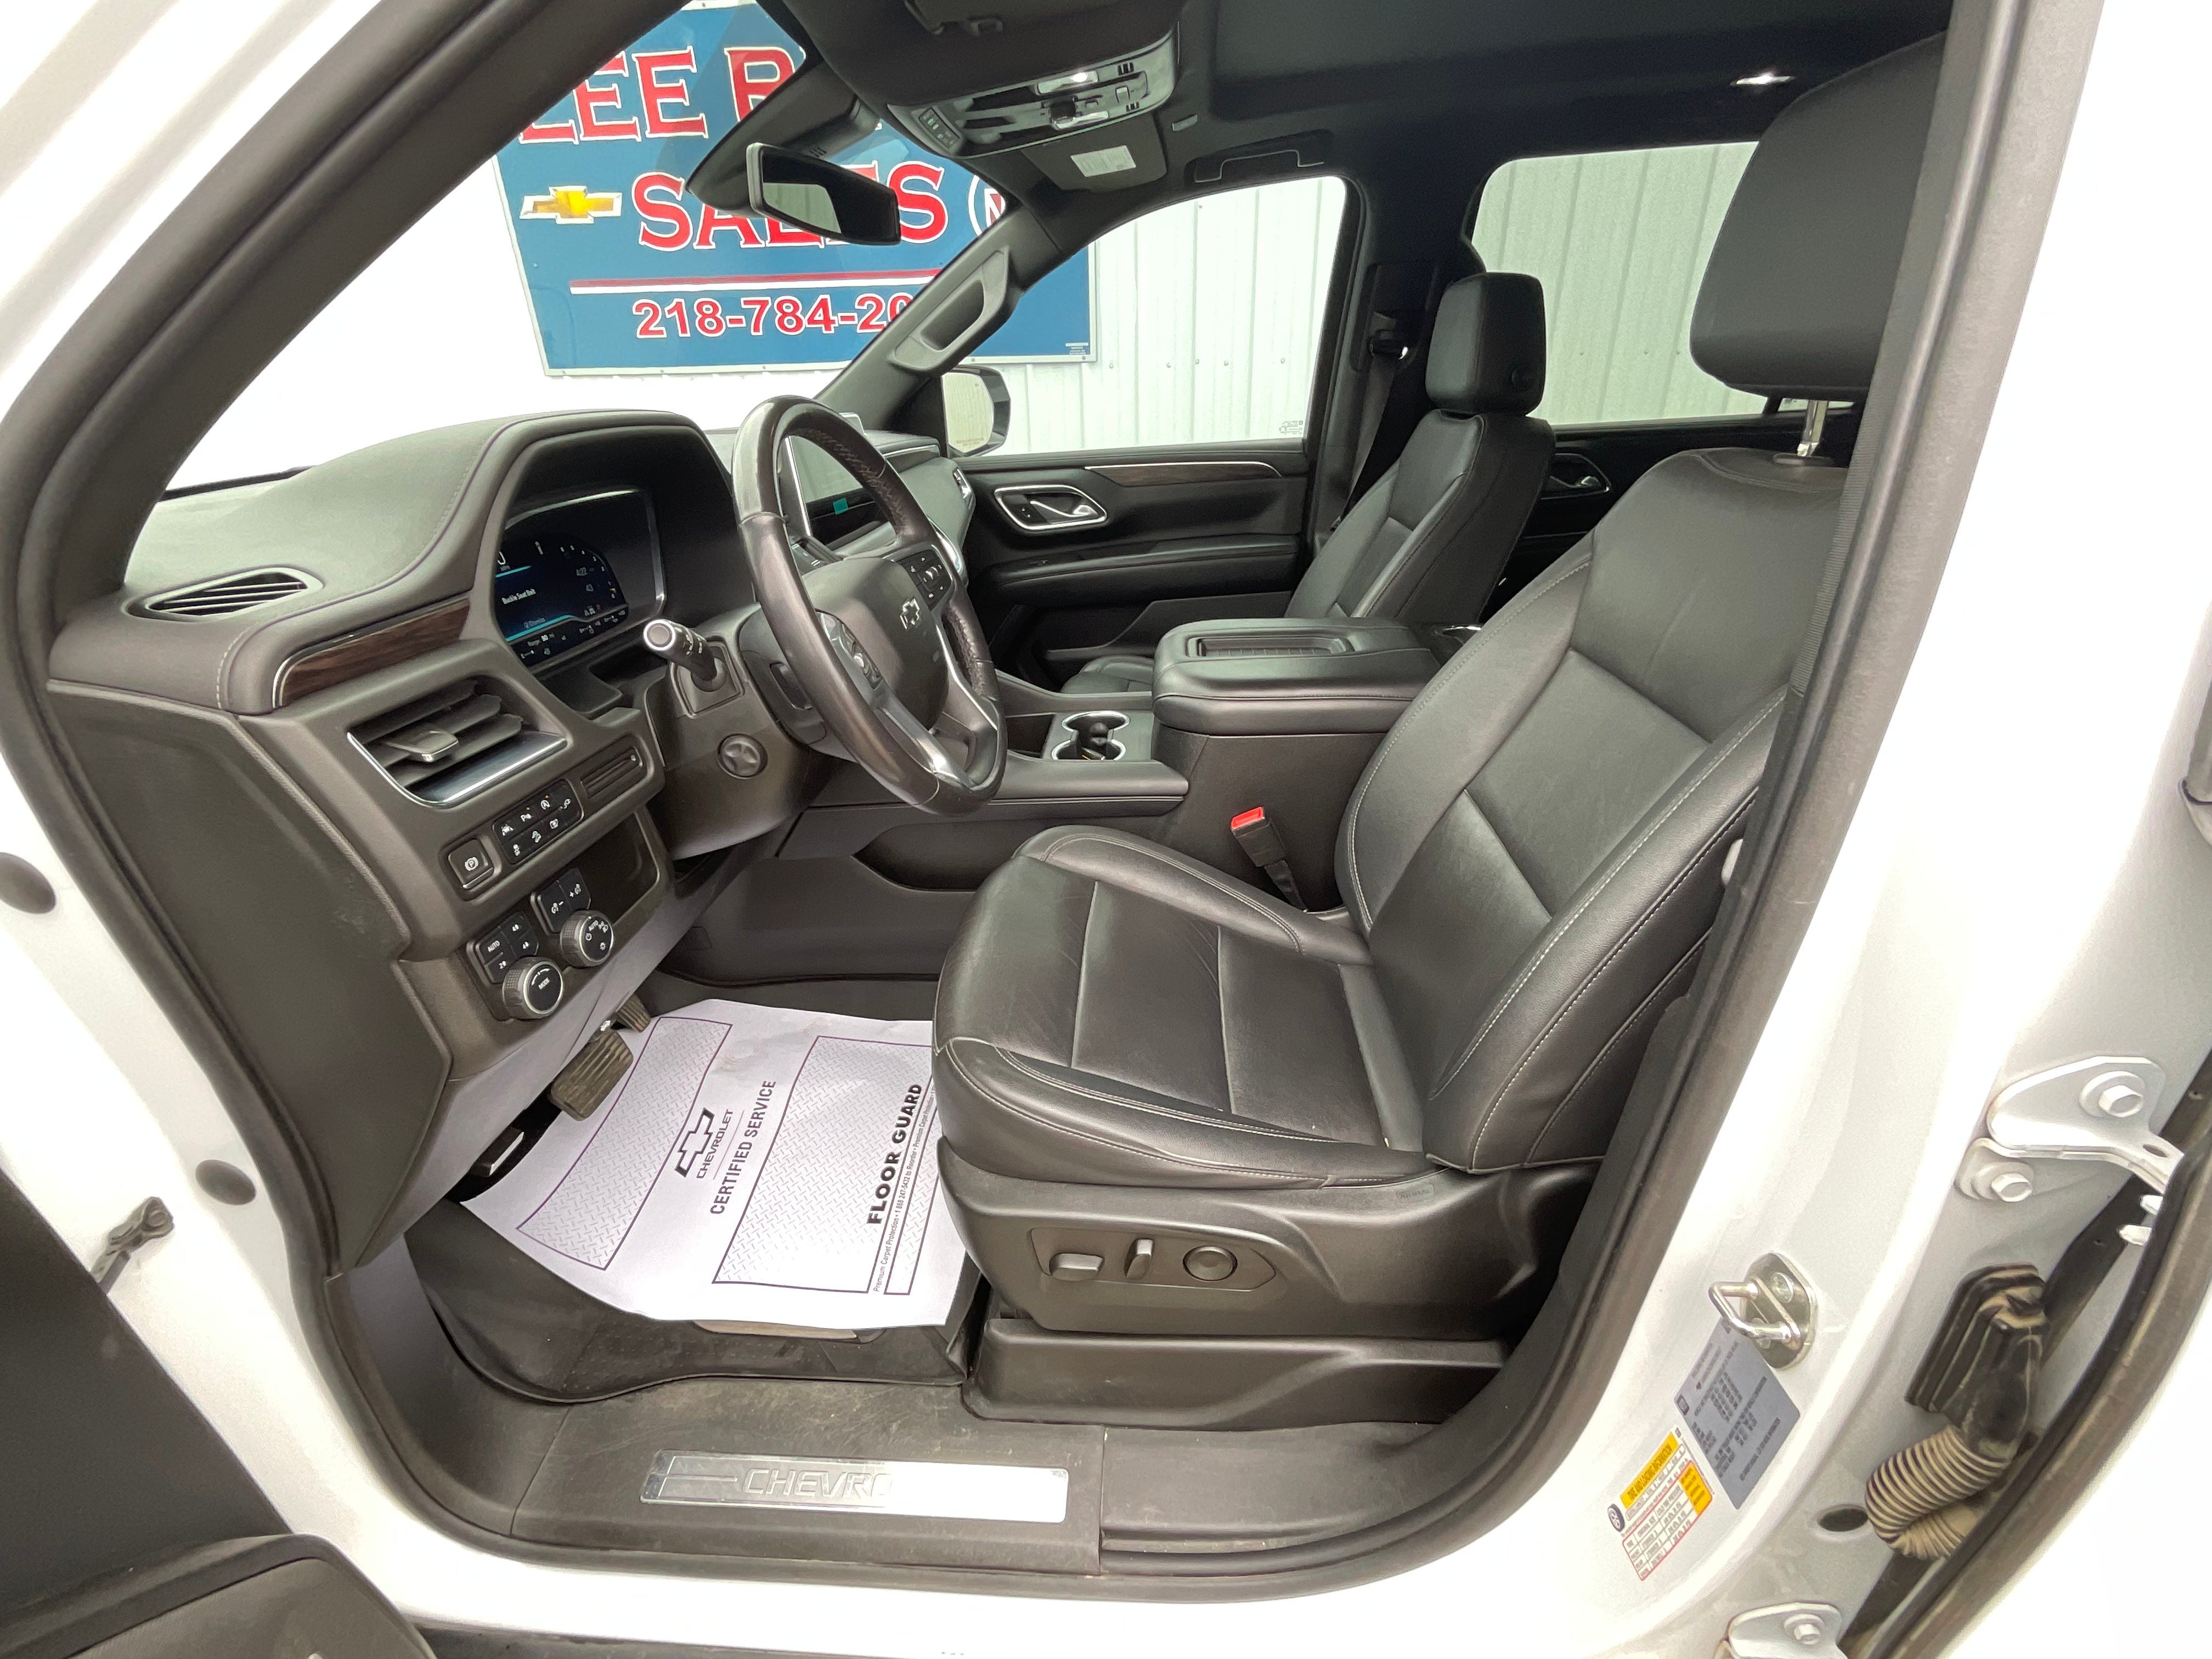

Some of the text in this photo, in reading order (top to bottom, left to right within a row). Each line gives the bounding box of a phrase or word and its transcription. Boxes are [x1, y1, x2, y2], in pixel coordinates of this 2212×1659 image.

[631, 160, 949, 252] SAS
[487, 940, 501, 953] AUTO
[696, 1108, 733, 1179] CHEVROLET
[710, 1080, 776, 1215] CERTIFIED SERVICE
[867, 1084, 922, 1224] FLOOR GUARD
[906, 1150, 917, 1170] Reorder
[886, 1218, 900, 1245] Protection
[881, 1245, 892, 1265] Carpet
[873, 1266, 885, 1292] Premium
